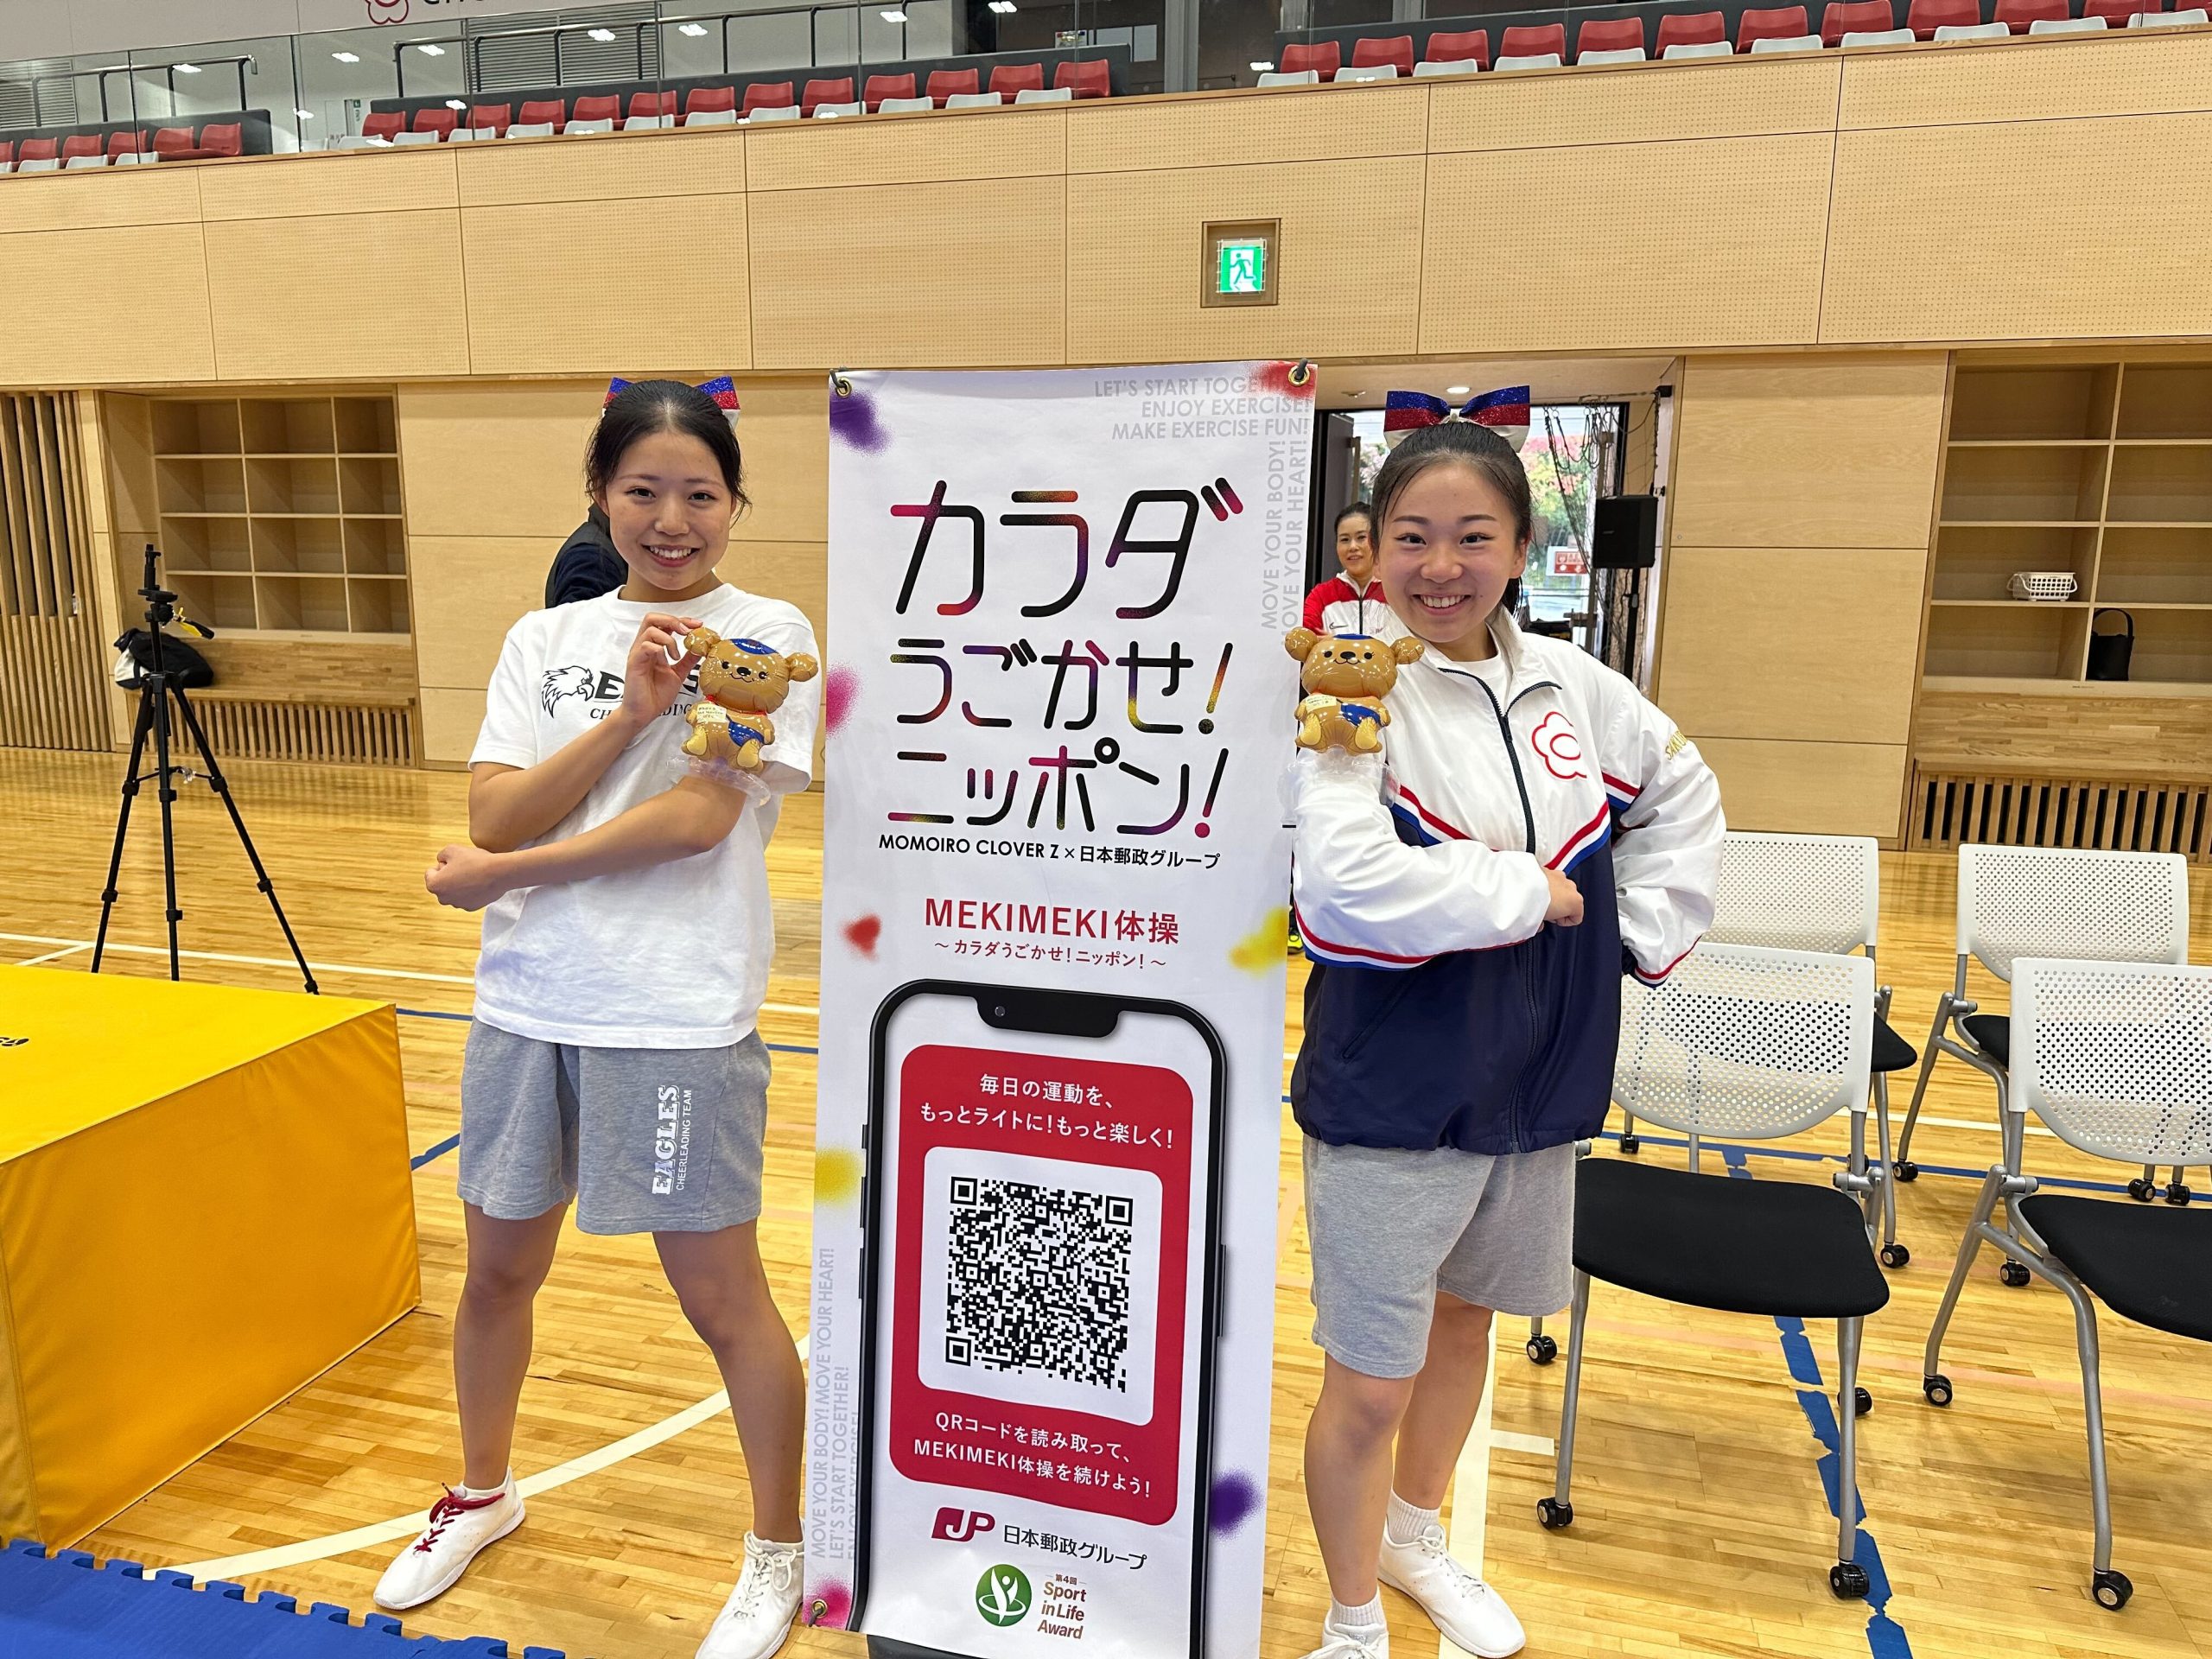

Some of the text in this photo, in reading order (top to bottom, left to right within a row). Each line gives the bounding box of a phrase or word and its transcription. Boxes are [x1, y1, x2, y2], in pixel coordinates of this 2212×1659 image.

[1095, 379, 1138, 397] LET'S
[1145, 378, 1198, 397] START
[1141, 397, 1310, 418] ENJOY EXERCISE!
[1112, 417, 1309, 440] MAKE EXERCISE FUN!
[1287, 440, 1306, 512] HEART!
[891, 477, 1243, 619] カラダ
[1262, 441, 1286, 629] MOVE YOUR BODY!
[1284, 519, 1303, 578] YOUR
[890, 639, 1234, 734] うごかせ！
[887, 736, 1229, 838] ニッポン！
[879, 834, 971, 854] MOMOIRO
[976, 839, 1046, 858] CLOVER
[1050, 844, 1060, 859] Z
[925, 898, 1179, 945] MEKIMEKI体操
[980, 1073, 1113, 1109] 毎日の運動を、
[652, 1084, 680, 1194] EAGLES
[676, 1090, 692, 1191] CHEERLEADING TEAM
[810, 1249, 835, 1559] MOVE YOUR BODY! MOVE YOUR HEART!
[830, 1366, 849, 1560] LET'S START TOGETHER!
[936, 1412, 1129, 1463] QRコードを読み取って、
[931, 1507, 1147, 1570] JP 日本郵政グループ
[1043, 1581, 1087, 1602] Sport
[1055, 1573, 1077, 1586] 第4回
[1037, 1619, 1084, 1640] Award
[1041, 1600, 1085, 1621] in Life
